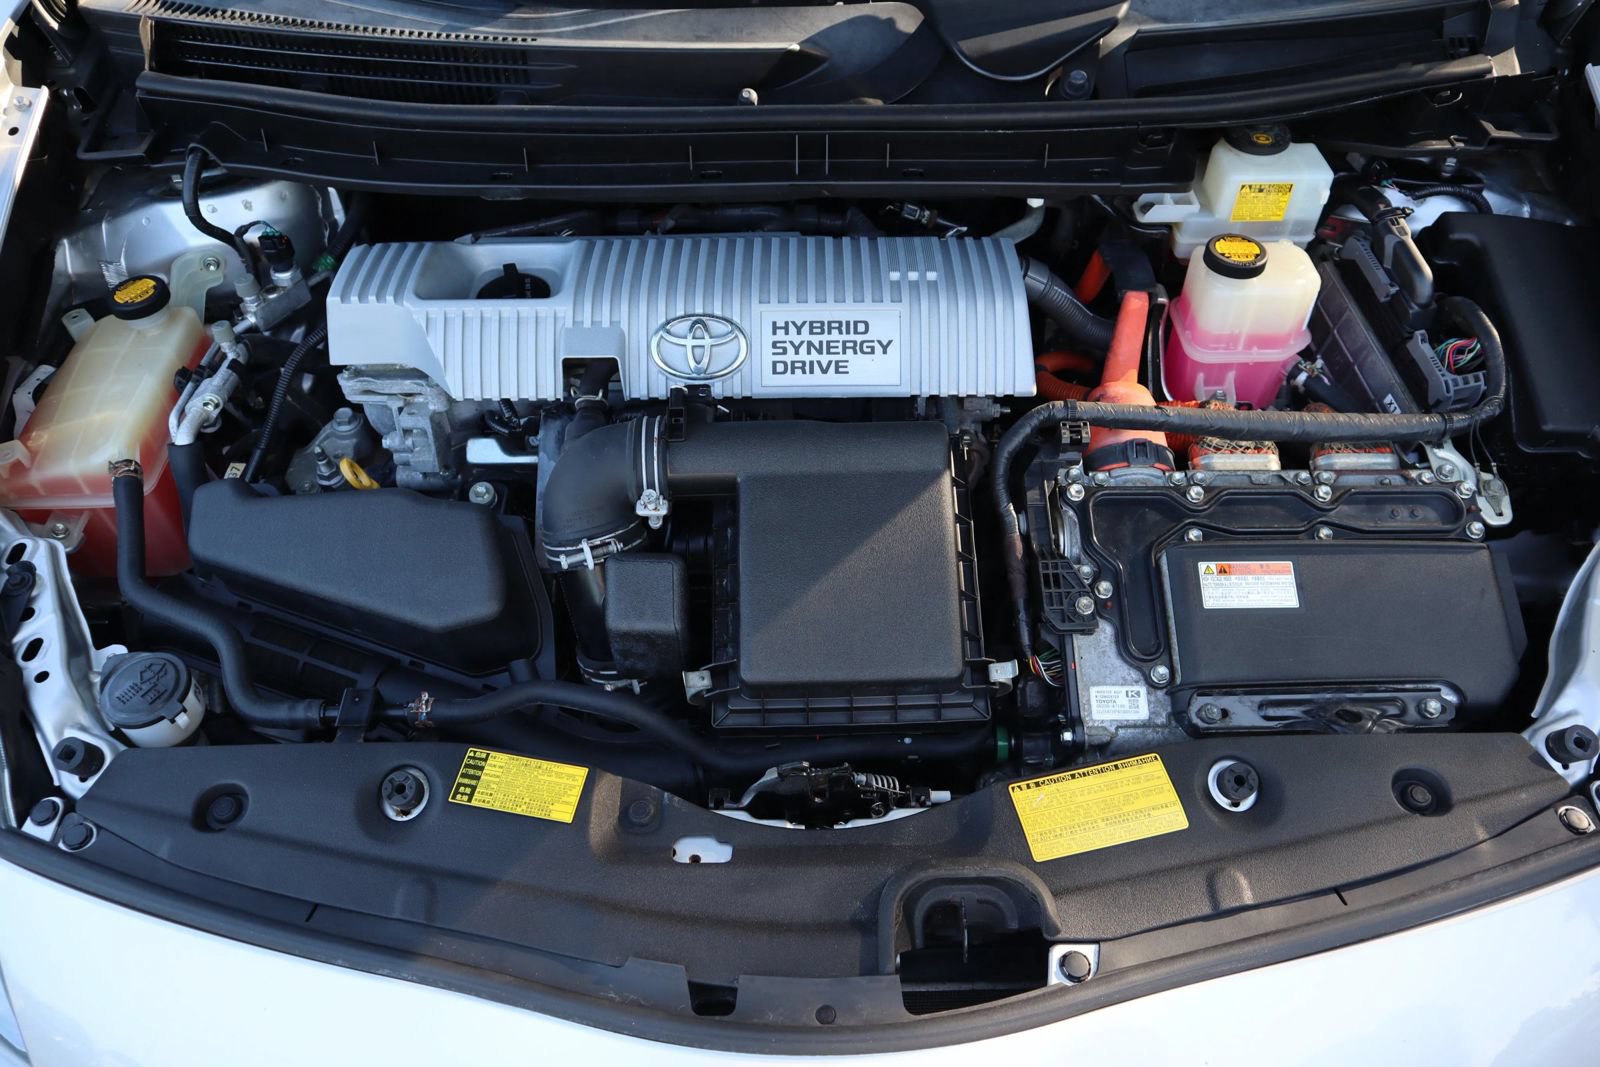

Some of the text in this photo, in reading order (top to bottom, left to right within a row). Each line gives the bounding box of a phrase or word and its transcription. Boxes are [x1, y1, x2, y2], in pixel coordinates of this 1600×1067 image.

[771, 320, 870, 336] HYBRID
[771, 339, 894, 356] SYNERGY
[771, 359, 850, 375] DRIVE
[465, 758, 486, 767] CAUTION
[462, 768, 482, 776] ATTENTION
[1038, 774, 1072, 788] CAUTION
[1075, 765, 1116, 780] ATTENTION
